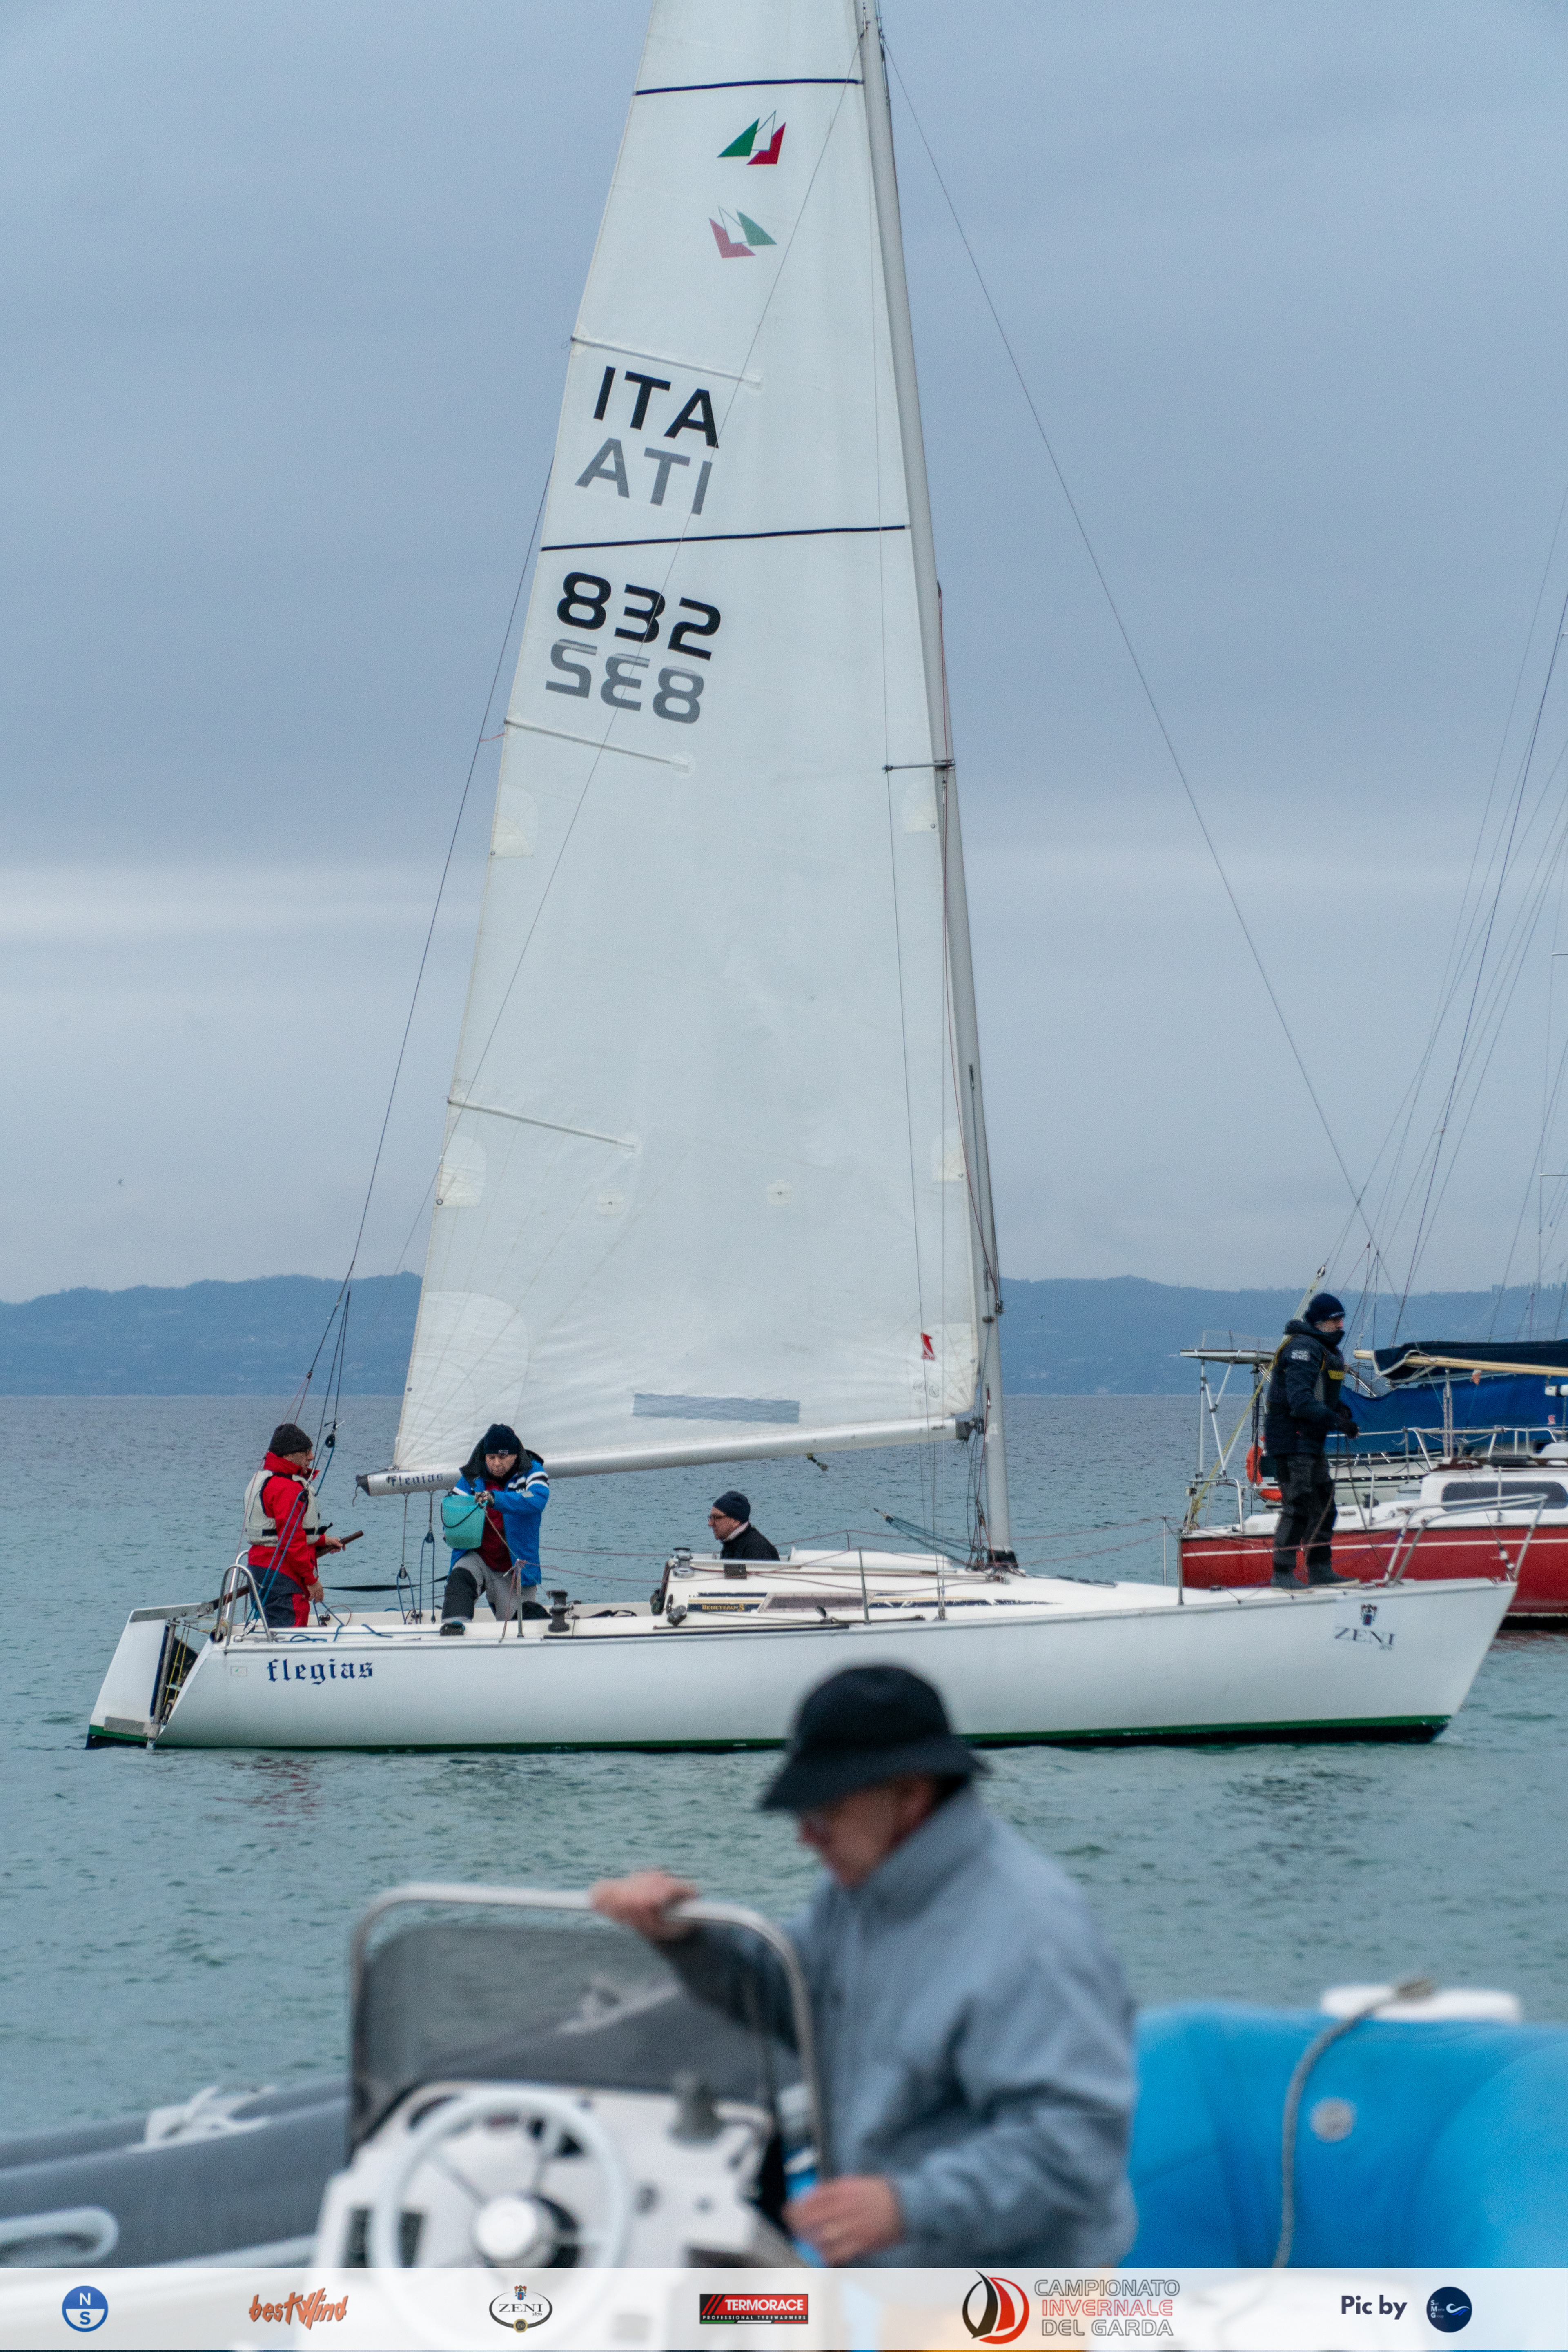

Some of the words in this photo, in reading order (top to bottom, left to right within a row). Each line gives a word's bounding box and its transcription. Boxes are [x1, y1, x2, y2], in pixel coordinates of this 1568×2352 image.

[593, 366, 719, 448] ITA
[557, 572, 721, 661] 832
[1334, 1626, 1395, 1645] ZENI
[267, 1658, 373, 1685] flegias
